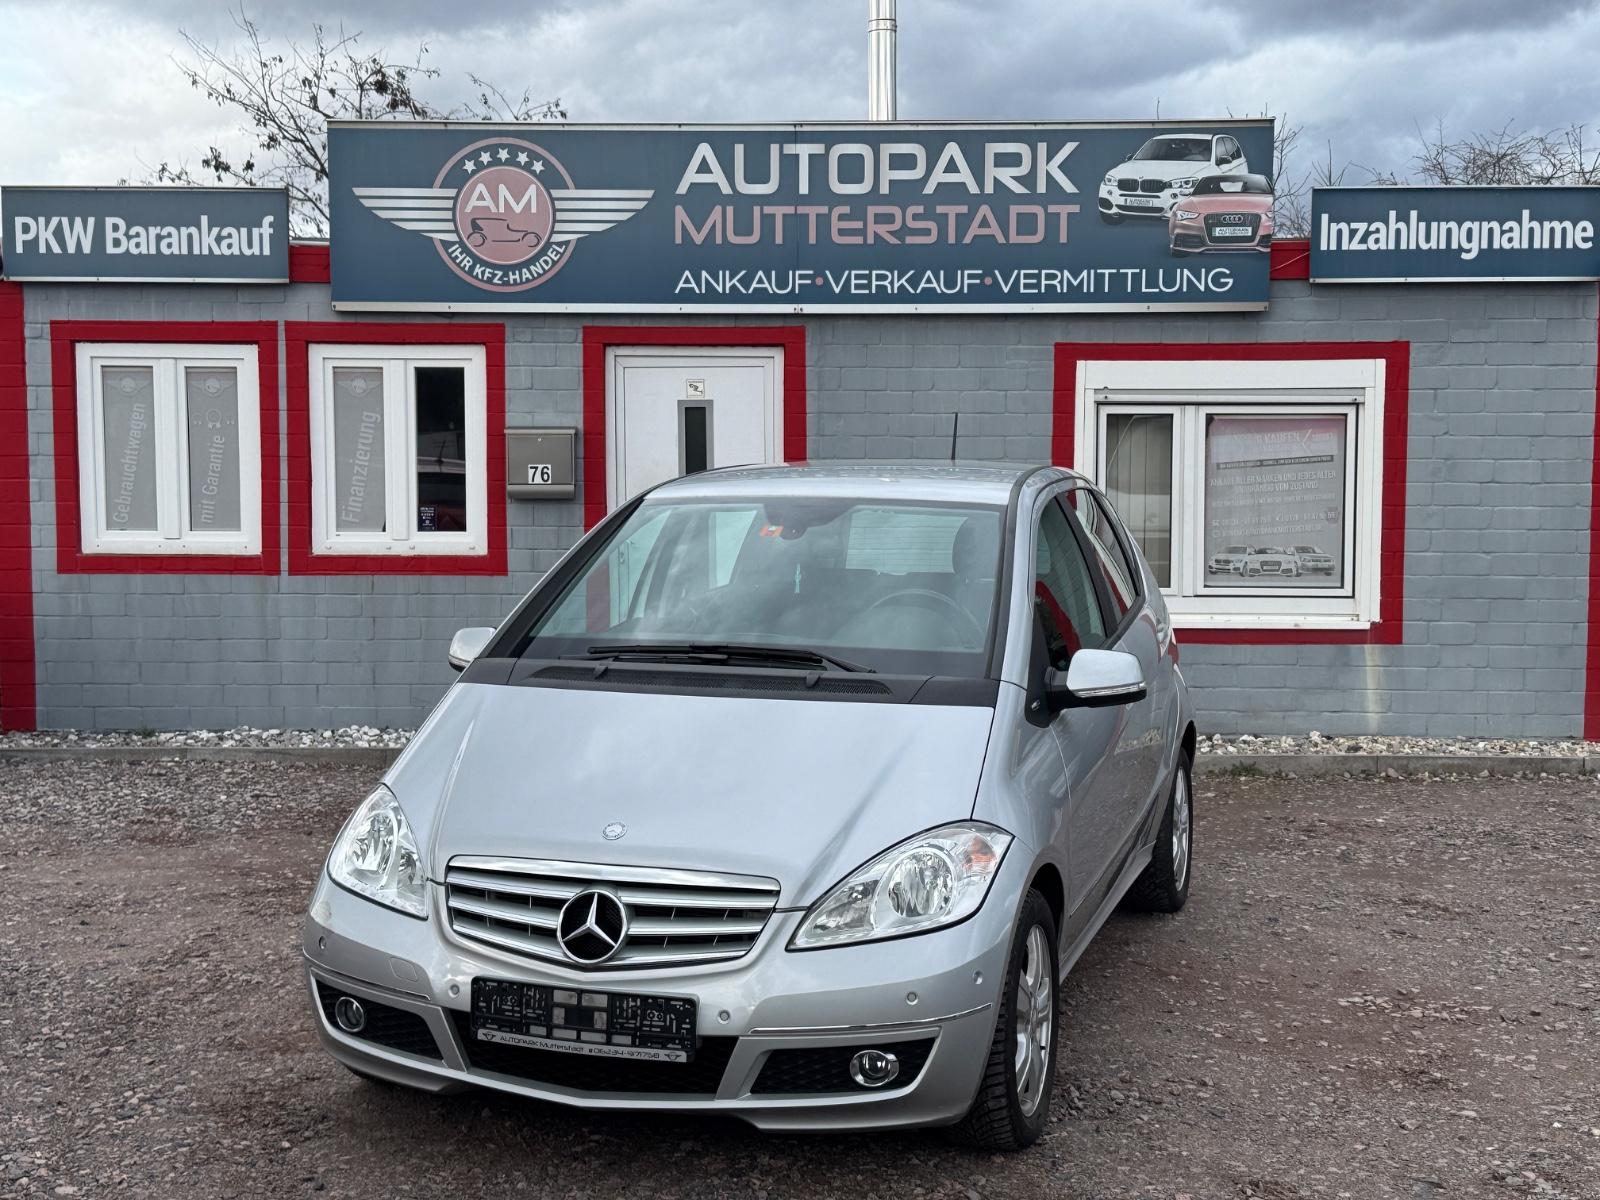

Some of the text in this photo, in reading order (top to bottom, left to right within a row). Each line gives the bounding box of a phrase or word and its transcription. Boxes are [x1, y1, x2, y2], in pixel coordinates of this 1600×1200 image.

[676, 142, 1080, 195] AUTOPARK
[464, 183, 537, 213] AM
[14, 214, 274, 256] PKW Barankauf
[674, 204, 1081, 246] MUTTERSTADT
[1320, 209, 1594, 260] Inzahlungnahme
[447, 244, 566, 284] IHR KFZ-HANDEL
[675, 268, 1234, 294] ANKAUF VERKAUF VERMITTLUNG
[113, 402, 147, 523] Gebrauchtwagen
[200, 434, 225, 523] mit Garantie
[342, 409, 381, 525] Finanzierung
[528, 466, 550, 482] 76
